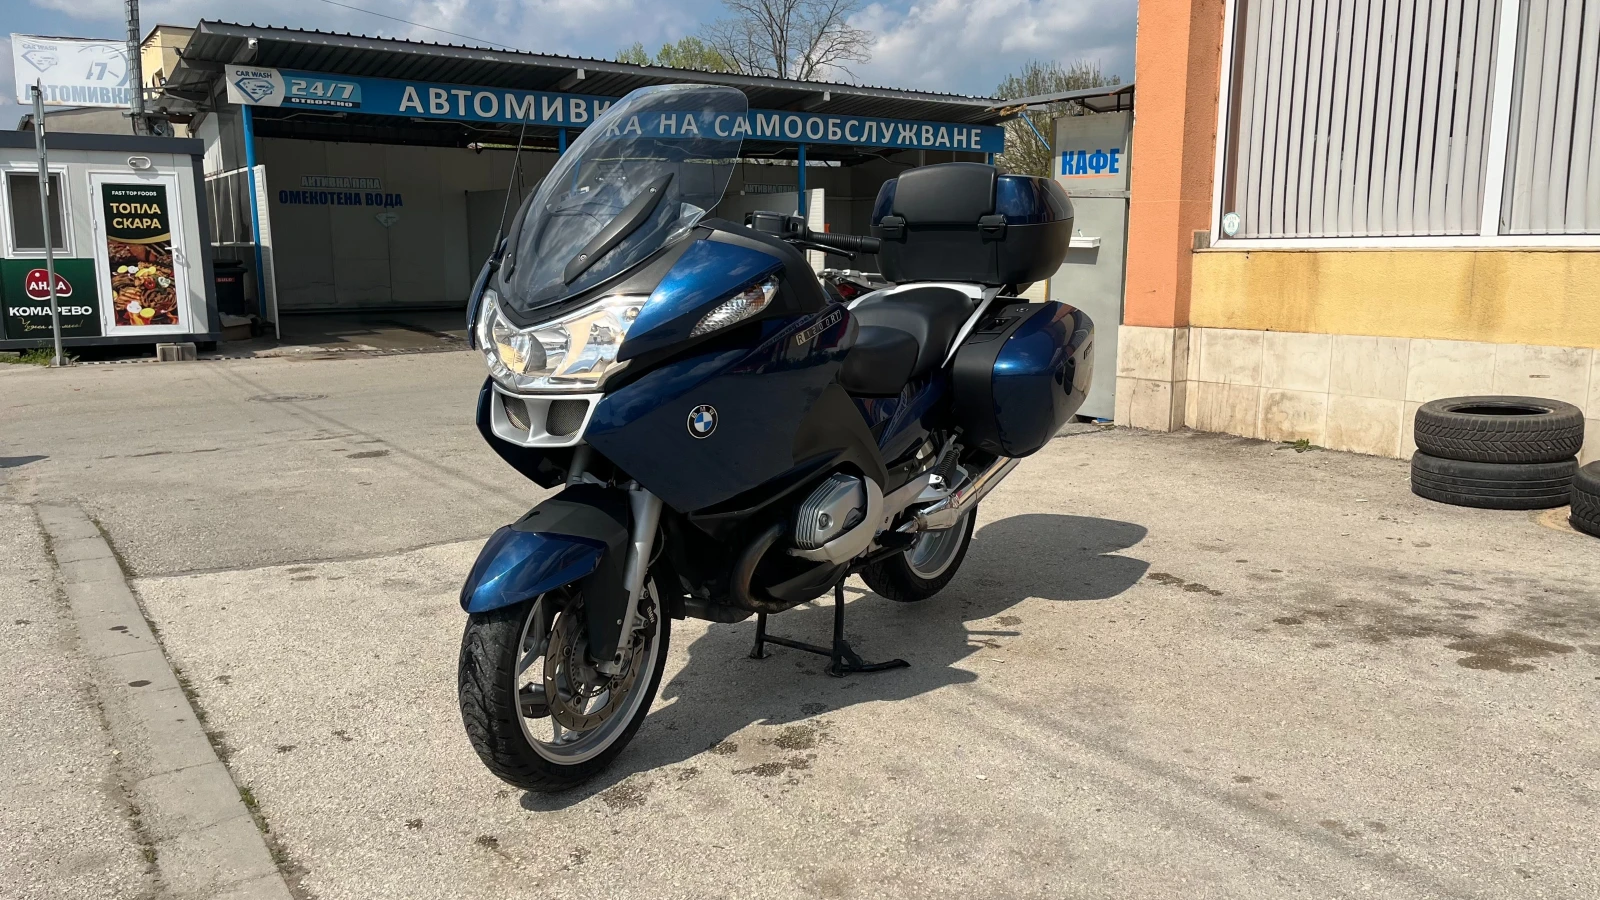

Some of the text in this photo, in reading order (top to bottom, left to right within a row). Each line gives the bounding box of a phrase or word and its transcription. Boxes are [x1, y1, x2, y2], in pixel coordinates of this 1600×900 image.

[252, 71, 272, 79] WASH
[291, 79, 354, 99] 24/7
[291, 98, 353, 107] ОТВОРЕНО
[659, 113, 699, 136] НА
[714, 113, 982, 149] САМООБСЛУЖВАНЕ
[1061, 148, 1120, 175] КАФЕ
[279, 190, 403, 208] ОМЕКОТЕНА ВОДА
[110, 203, 161, 214] ТОПЛА
[112, 217, 162, 229] СКАРА
[29, 281, 67, 291] АНА
